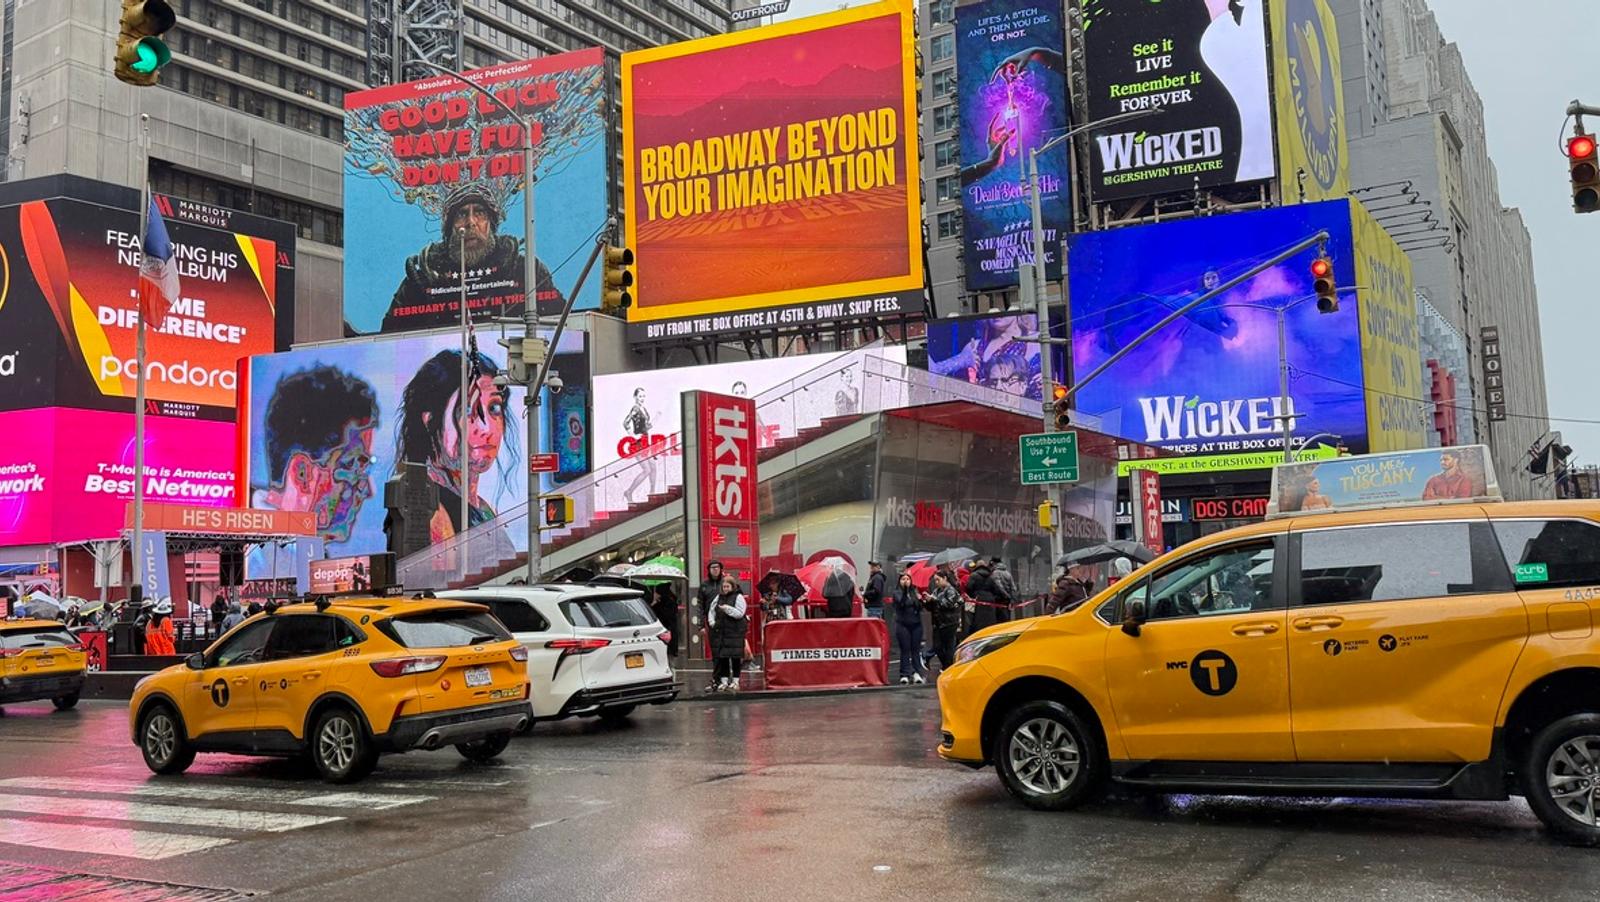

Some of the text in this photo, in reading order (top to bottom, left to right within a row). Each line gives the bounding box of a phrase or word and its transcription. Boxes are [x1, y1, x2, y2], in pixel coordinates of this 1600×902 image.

[968, 15, 1050, 37] AND THEN YOU DIE.
[978, 15, 1001, 27] LIFE'S
[991, 34, 1004, 42] OR
[1132, 38, 1173, 57] See it
[1136, 55, 1173, 73] LIVE
[1109, 71, 1201, 98] Remember it
[379, 79, 560, 131] GOOD LUCK
[1120, 89, 1193, 112] FOREVER
[393, 128, 472, 157] HAVE
[639, 107, 897, 185] BROADWAY BEYOND
[1112, 159, 1224, 184] GERSHWIN THEATRE
[642, 147, 896, 222] YOUR IMAGINATION
[968, 185, 1001, 205] Death
[1042, 174, 1061, 194] Her
[179, 200, 233, 219] MARRIOTT
[179, 210, 227, 227] MARQUIS
[211, 250, 238, 269] HIS
[995, 241, 1034, 260] MUSICAL
[176, 260, 227, 283] LBUM
[980, 256, 1015, 272] COMEDY
[393, 303, 446, 317] FEBRUARY
[448, 301, 459, 311] 13
[491, 296, 502, 306] IN
[504, 290, 559, 304] THEERS
[647, 296, 901, 338] BUY FROM THE BOX OFFICE AT 45TH & BWAY. SKIP FEES.
[1486, 343, 1503, 420] HOTEL
[163, 402, 200, 412] MARRIOTT
[163, 408, 196, 418] MARQUIS
[1025, 435, 1072, 447] Southbound
[1200, 442, 1216, 452] AT
[1217, 440, 1240, 452] THE
[1242, 439, 1265, 450] BOX
[1029, 446, 1067, 456] Use 7 Ave
[97, 463, 158, 477] T-Moile
[159, 466, 171, 477] is
[713, 405, 749, 517] tkts
[1178, 461, 1190, 470] at
[1191, 459, 1207, 469] the
[1209, 456, 1265, 468] GERSHWIN
[1028, 470, 1072, 481] Best Route
[1339, 466, 1416, 493] TUSCANY
[146, 477, 236, 499] Networ
[1145, 475, 1158, 539] tkts
[1196, 500, 1228, 518] DOS
[182, 509, 222, 527] HE'S
[225, 512, 273, 529] RISEN
[314, 568, 349, 581] depop
[1517, 565, 1545, 575] curb
[781, 648, 872, 660] TIMES SQUARE
[1166, 661, 1188, 670] NYC
